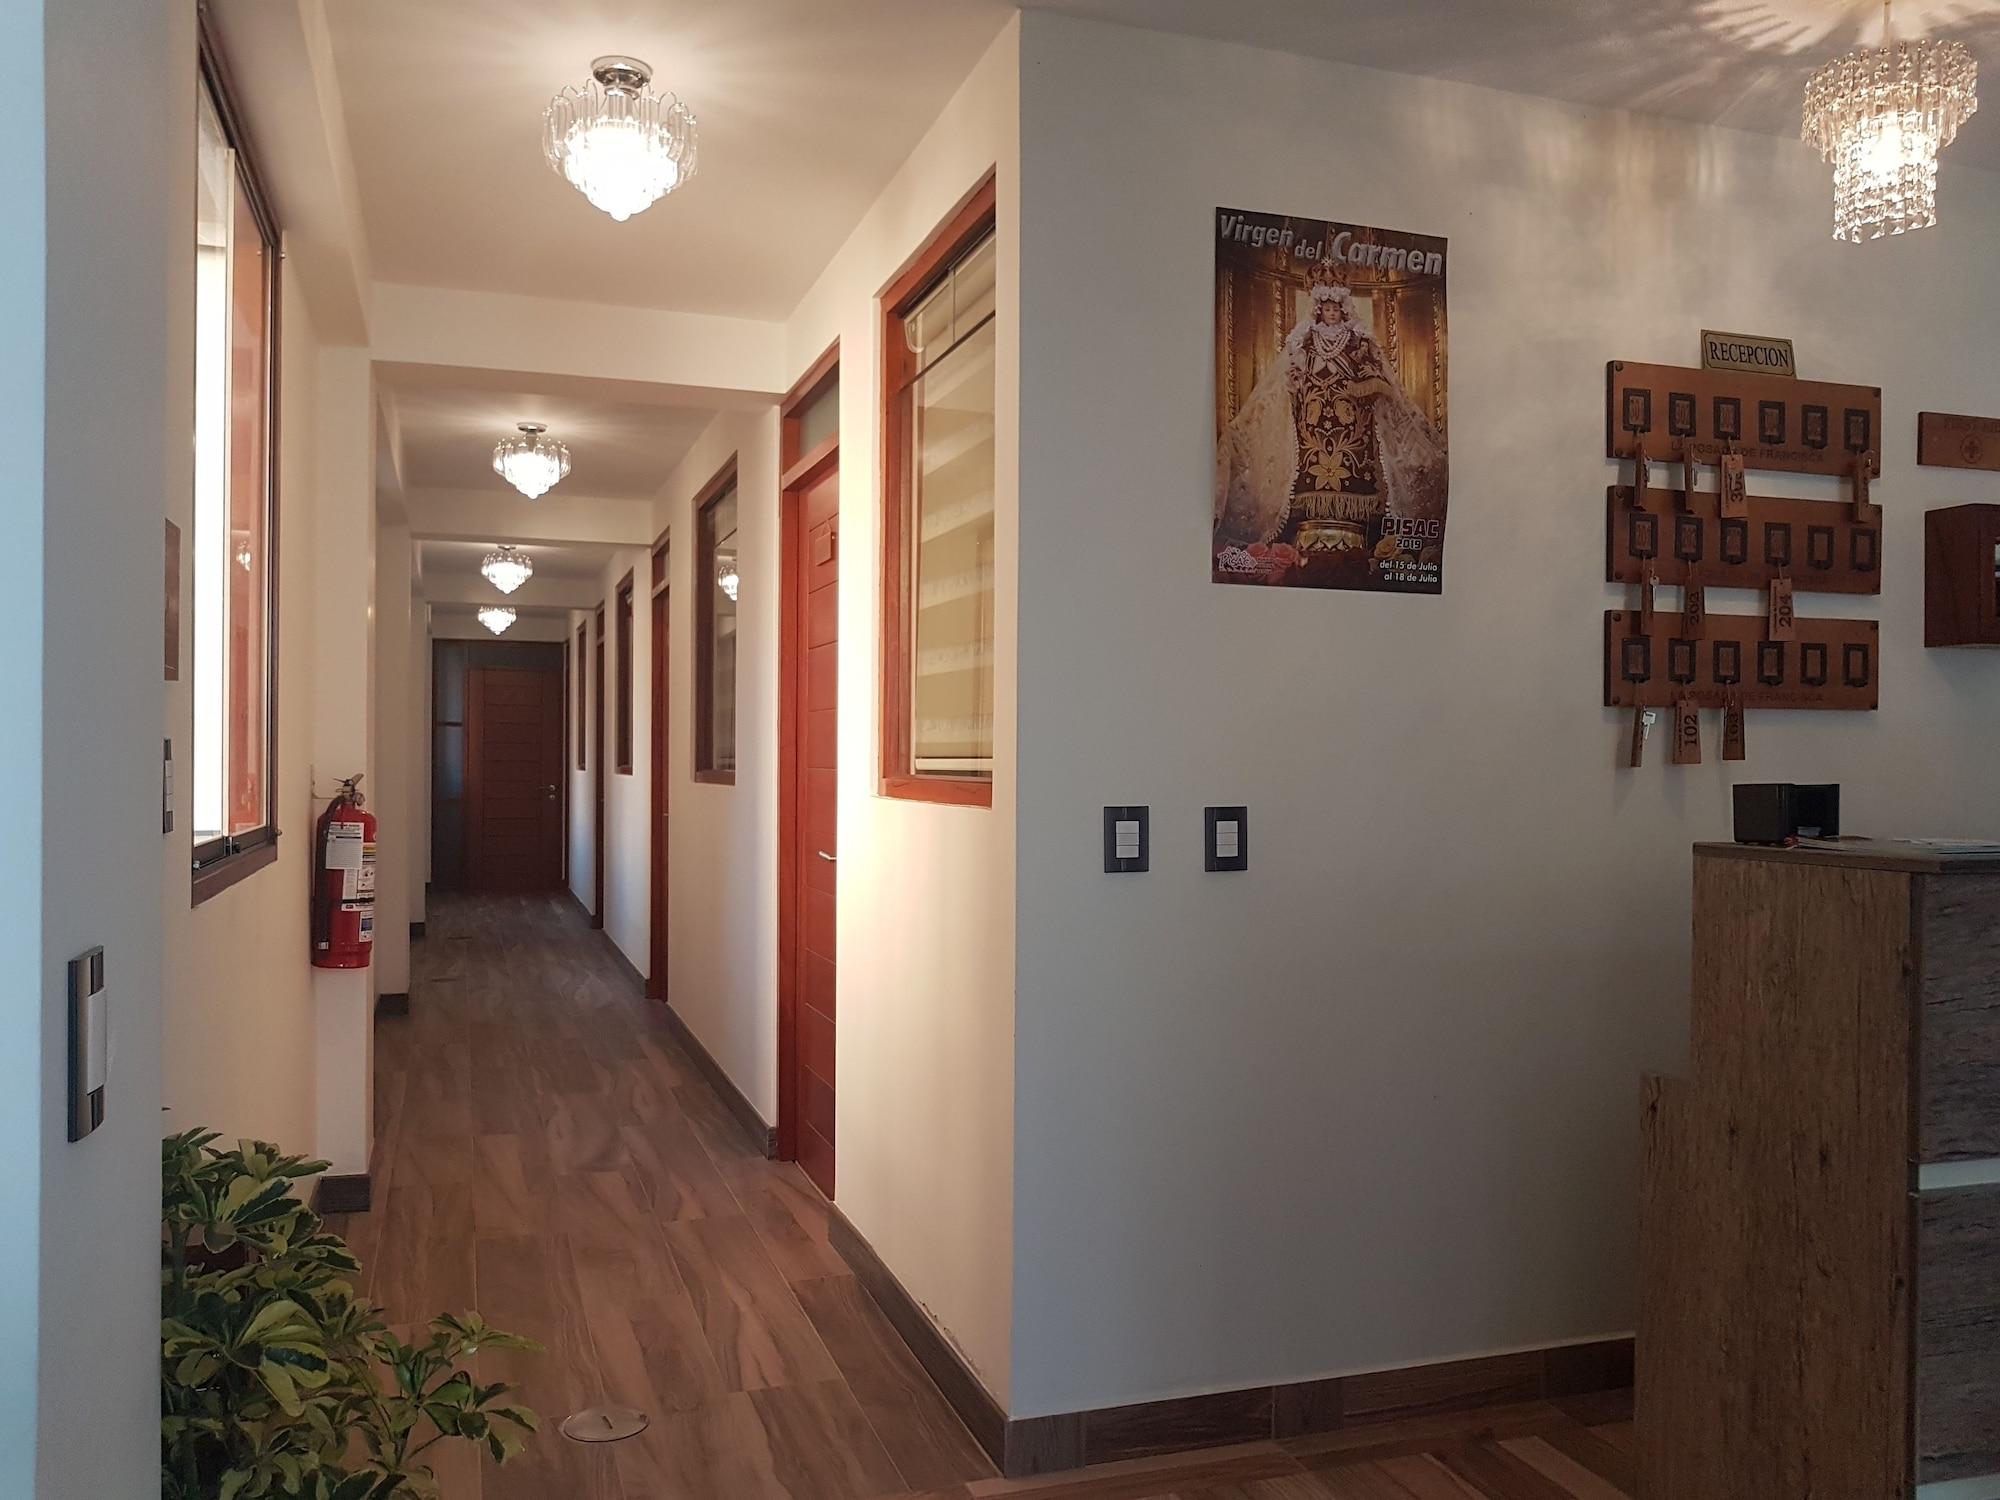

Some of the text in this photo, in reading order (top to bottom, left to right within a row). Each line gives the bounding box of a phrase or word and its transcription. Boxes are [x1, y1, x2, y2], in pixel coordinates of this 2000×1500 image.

[1220, 214, 1443, 275] Virgen del Carmen
[1709, 341, 1789, 368] RECEPCION
[1381, 516, 1439, 538] PISAC
[1395, 537, 1422, 550] 2019
[1380, 560, 1438, 572] del 15 de Julio
[1384, 572, 1438, 583] al 18 de Julio
[1779, 594, 1792, 628] 204
[1684, 714, 1697, 746] 102
